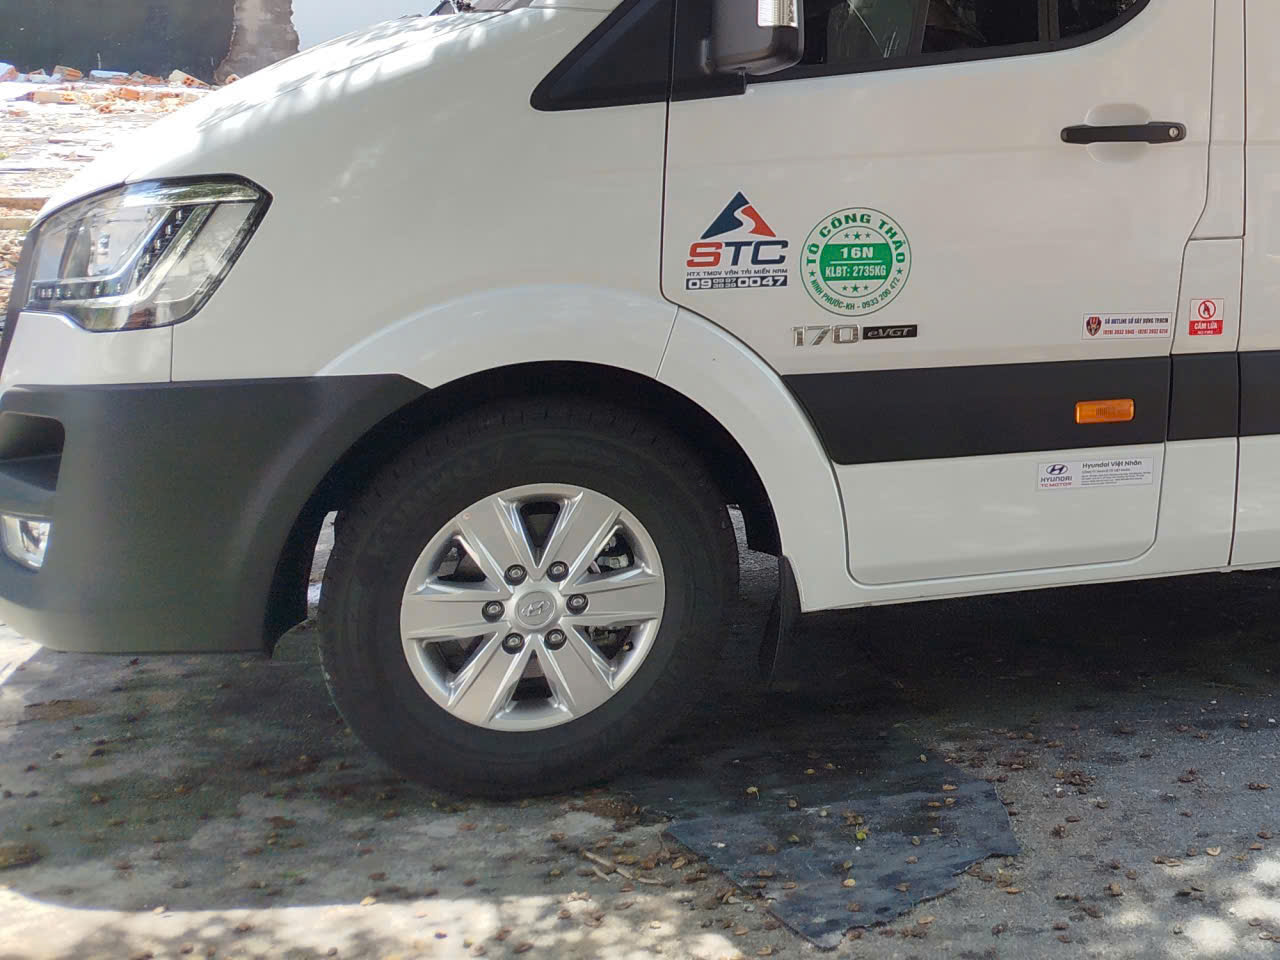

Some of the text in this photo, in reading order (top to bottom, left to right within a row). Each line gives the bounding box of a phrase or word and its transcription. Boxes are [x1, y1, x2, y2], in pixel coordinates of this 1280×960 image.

[819, 213, 872, 238] CÔNG
[686, 240, 789, 268] STC
[840, 246, 874, 259] 16N
[825, 265, 887, 278] KLBT: 2735KG
[1082, 461, 1110, 469] Hyundai
[1040, 475, 1073, 483] HYUNDAI
